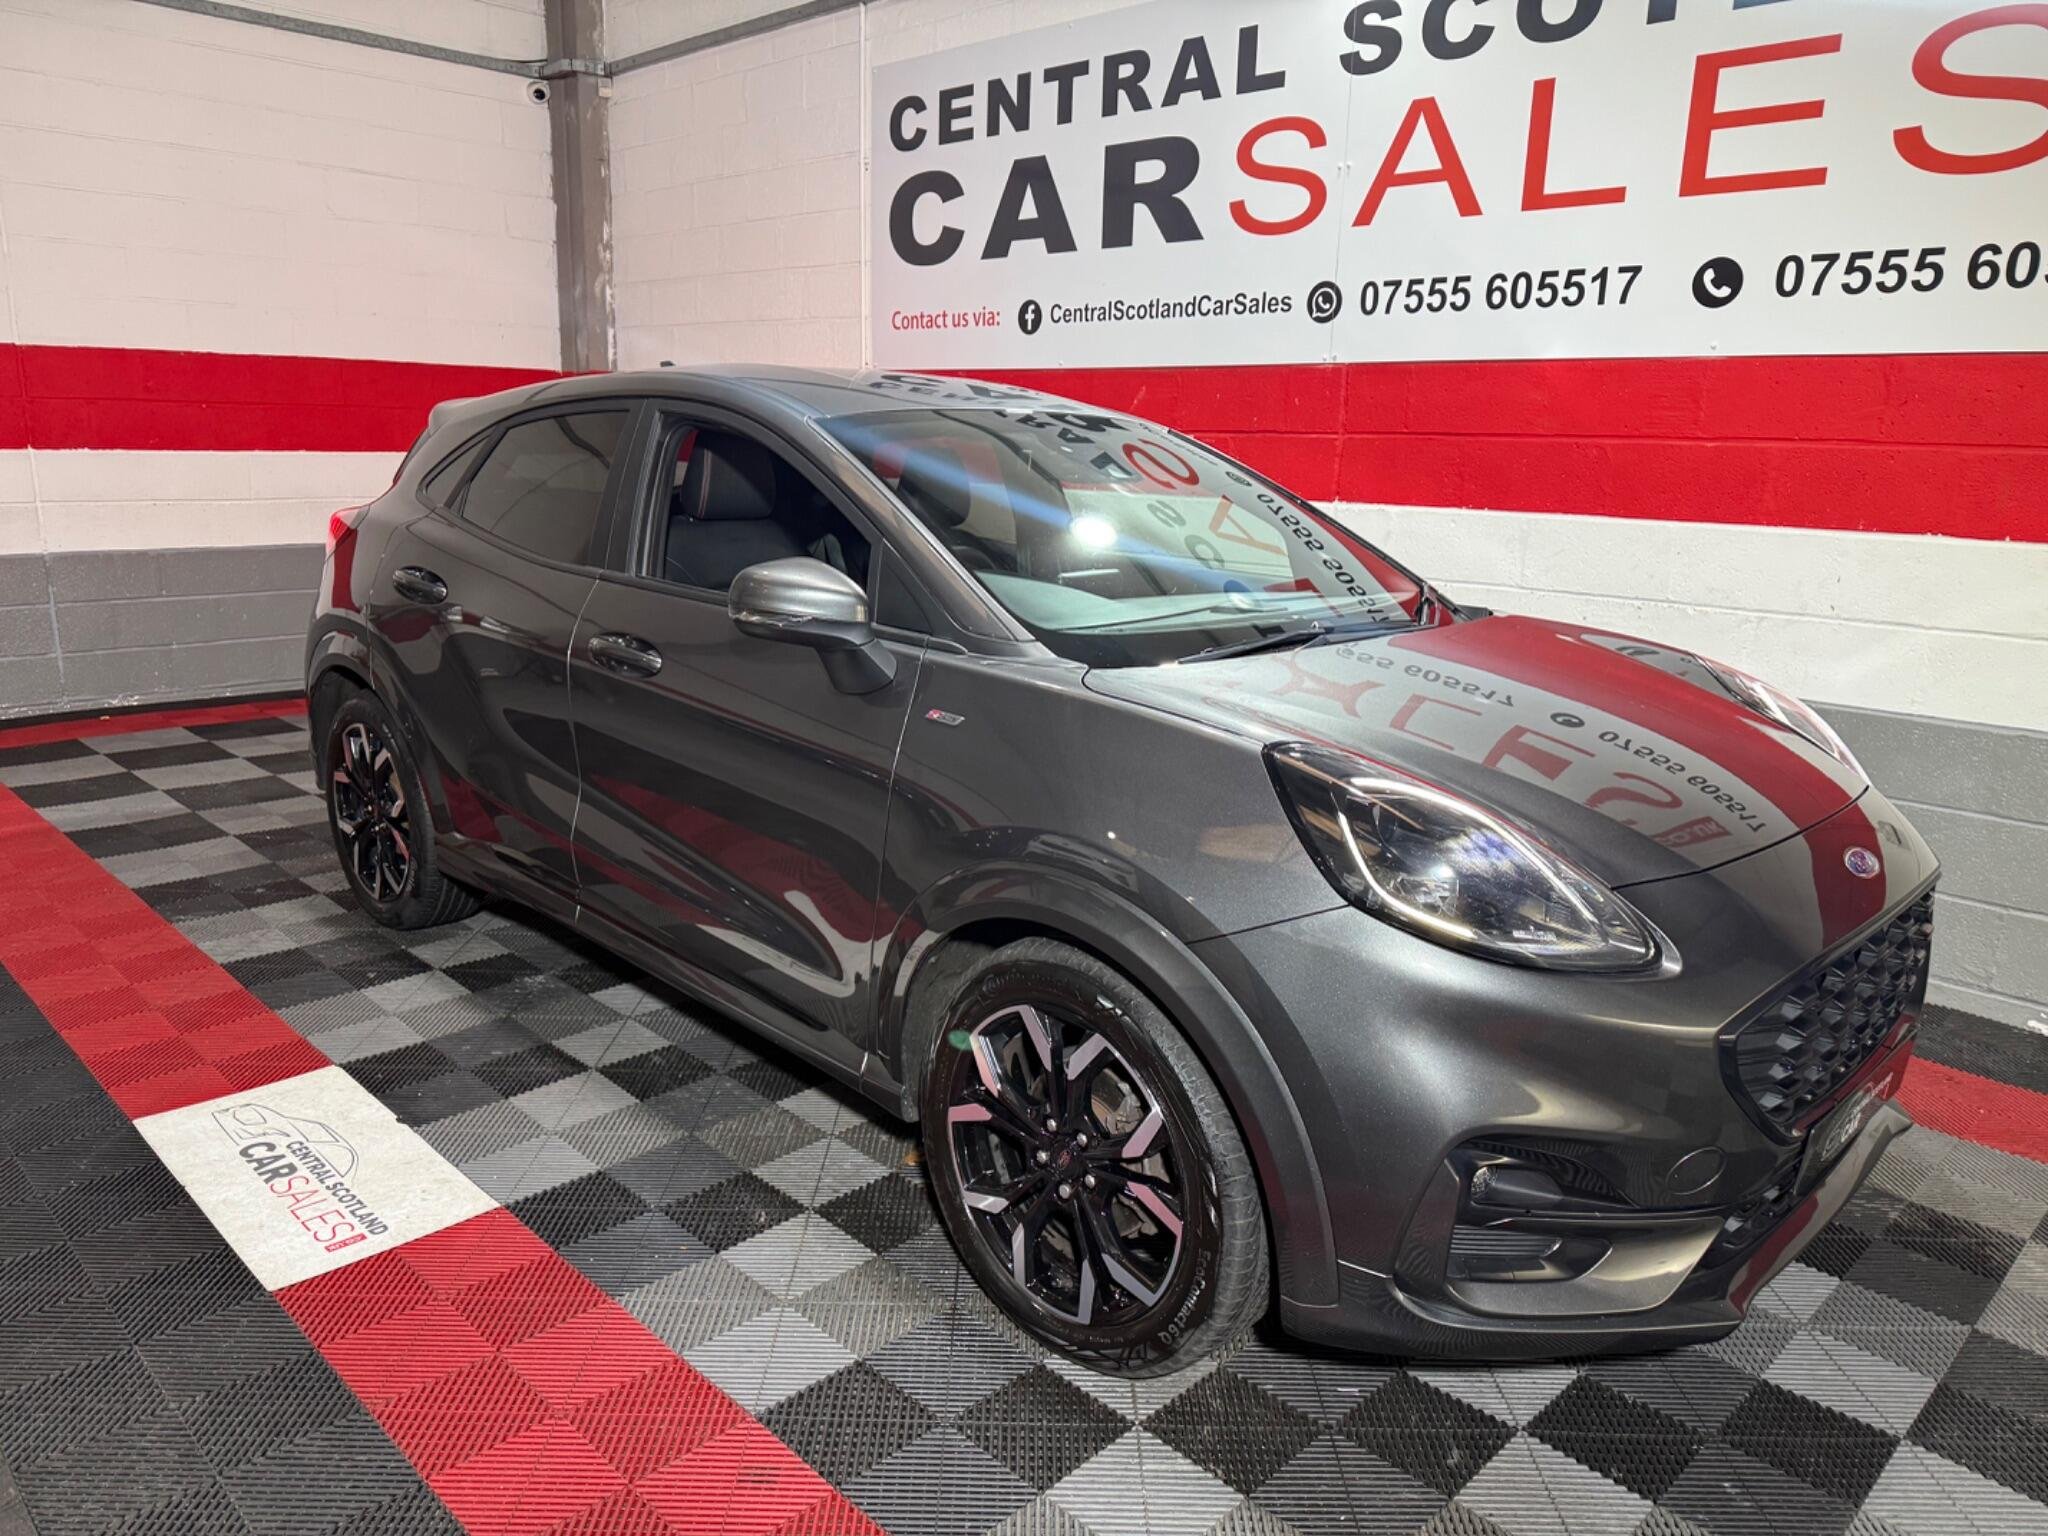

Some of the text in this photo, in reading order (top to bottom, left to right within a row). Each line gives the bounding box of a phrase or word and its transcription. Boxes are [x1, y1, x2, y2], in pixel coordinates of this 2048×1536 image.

[889, 24, 1286, 152] CENTRAL
[1360, 265, 1643, 315] 07555 605517
[1775, 241, 2048, 298] 07555 60
[892, 306, 1000, 330] Contact us via:
[1050, 291, 1292, 324] CentralScotlandCarSales
[286, 1141, 338, 1185] CENTRAL
[325, 1182, 389, 1236] SCOTLAND
